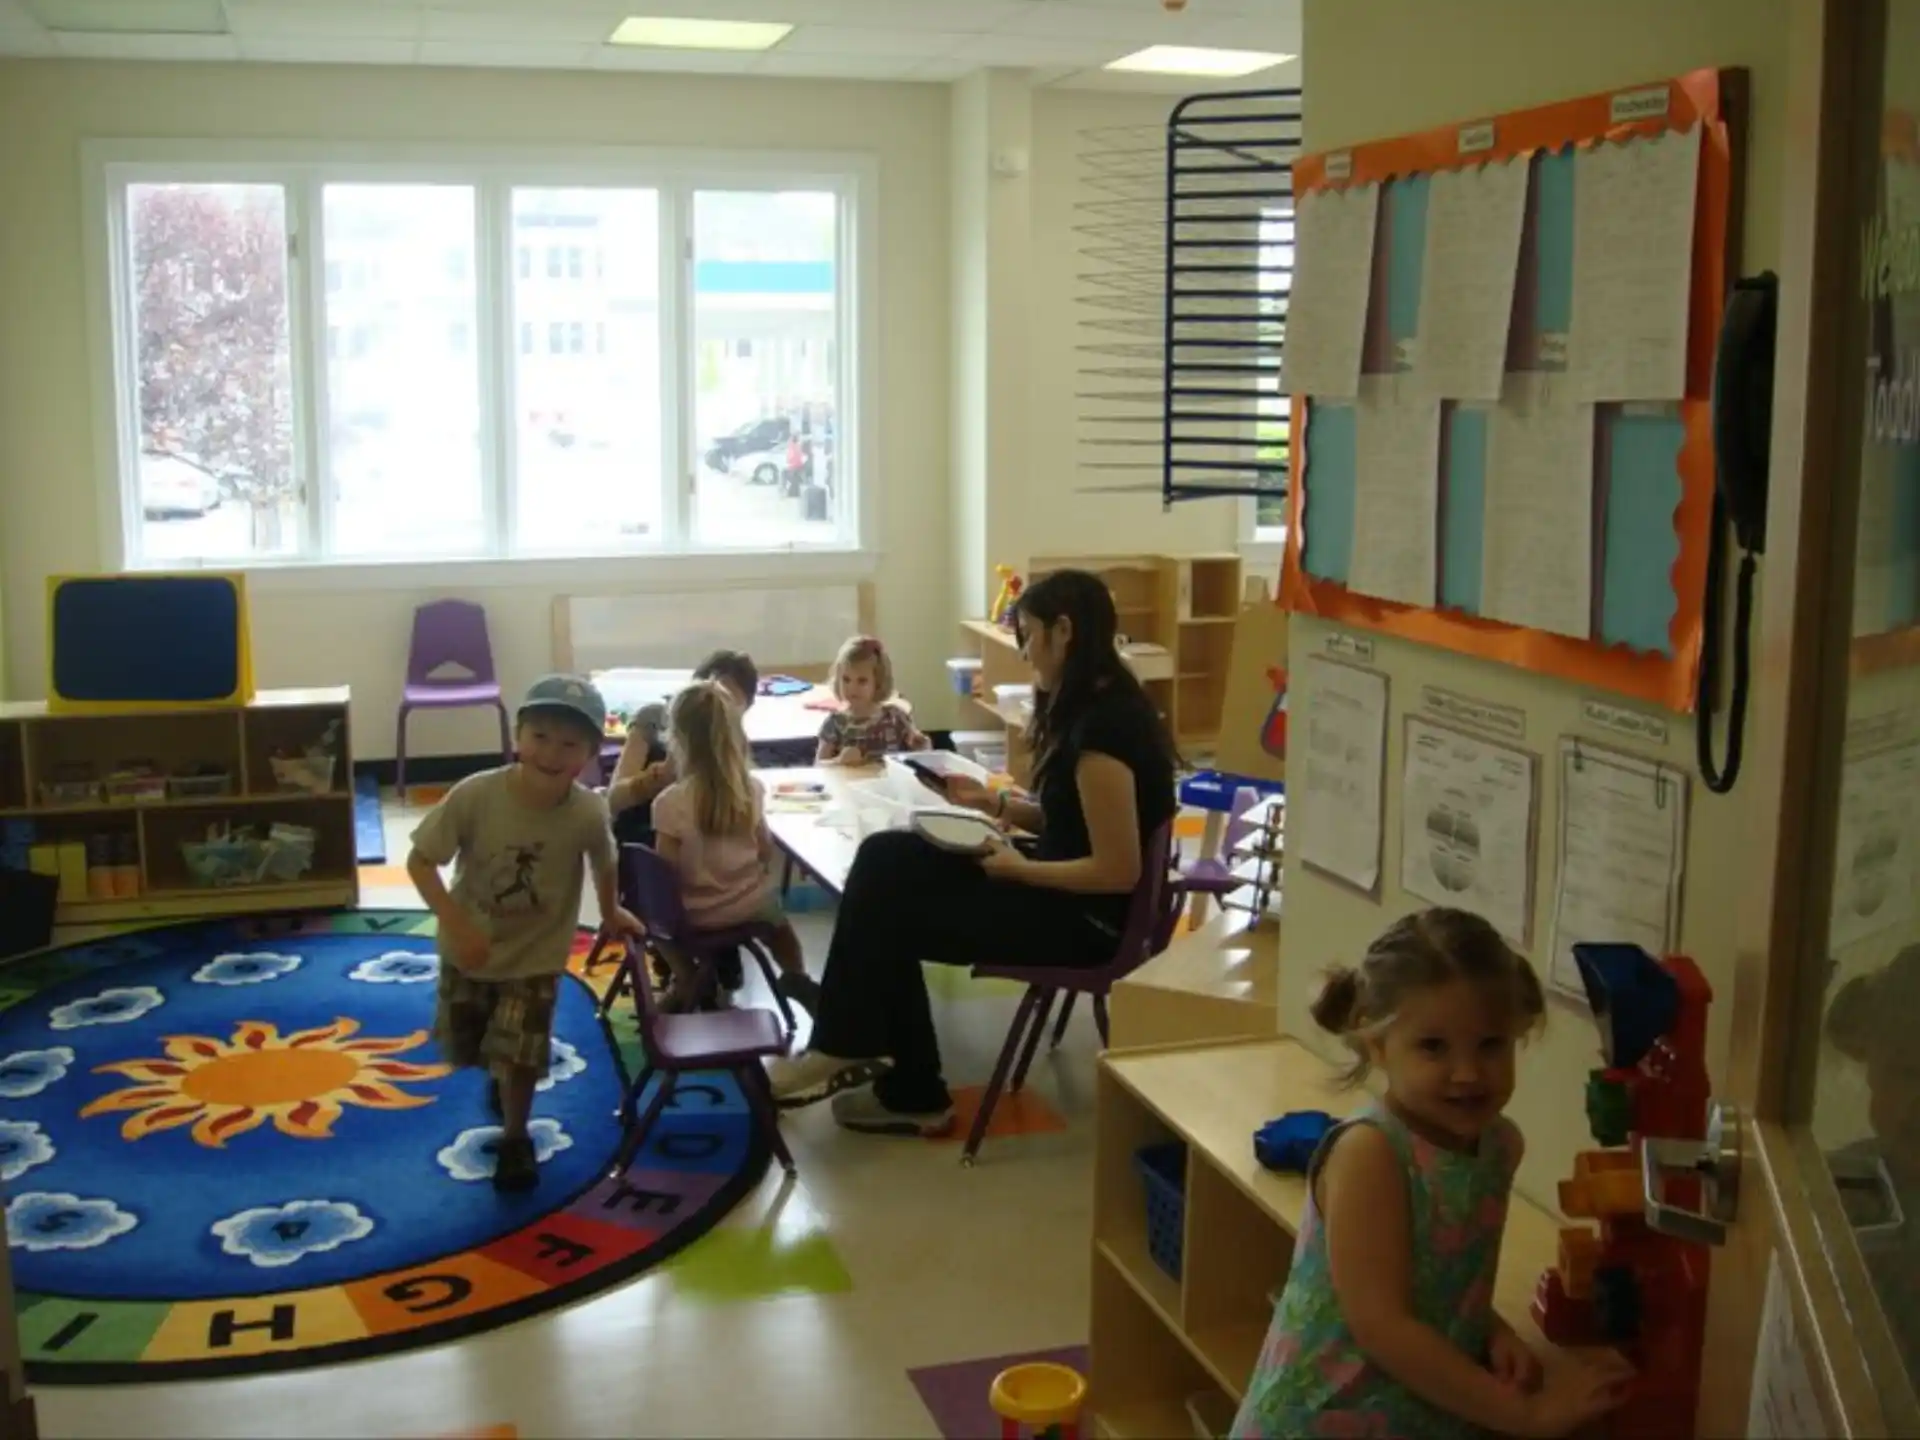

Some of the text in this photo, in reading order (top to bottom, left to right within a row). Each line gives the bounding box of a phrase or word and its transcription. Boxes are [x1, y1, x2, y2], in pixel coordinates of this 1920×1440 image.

[655, 1133, 724, 1158] D
[602, 1186, 682, 1214] E
[535, 1232, 595, 1267] F
[383, 1274, 472, 1313] G
[41, 1312, 98, 1351] I
[208, 1304, 295, 1348] H
